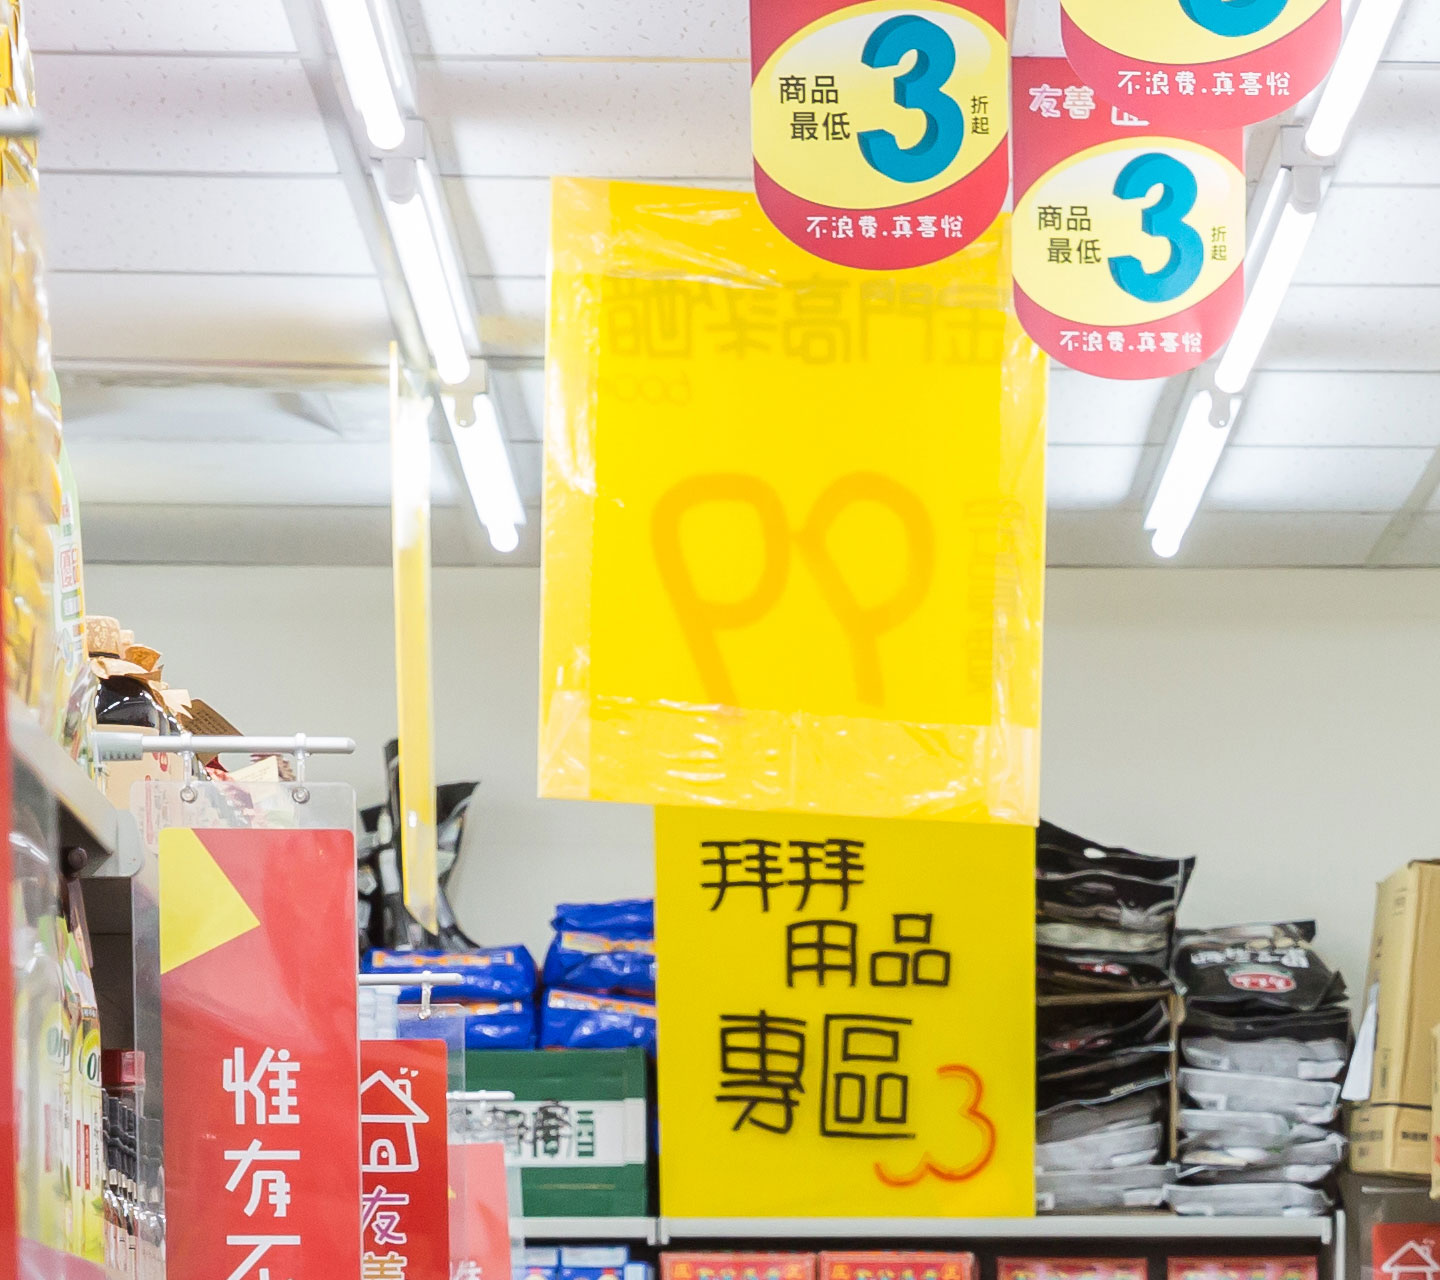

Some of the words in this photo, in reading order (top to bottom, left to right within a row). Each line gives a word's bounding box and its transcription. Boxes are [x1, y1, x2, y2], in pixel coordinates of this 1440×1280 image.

[779, 75, 839, 105] 商品
[857, 13, 964, 185] 3
[790, 112, 851, 142] 最低
[970, 95, 990, 136] 折起
[1037, 205, 1093, 233] 商品
[1107, 151, 1206, 305] 3
[1046, 238, 1102, 267] 最低
[1210, 226, 1228, 262] 折起
[700, 838, 866, 912] 拜拜
[786, 912, 951, 989] 用品
[715, 1010, 916, 1140] 專區
